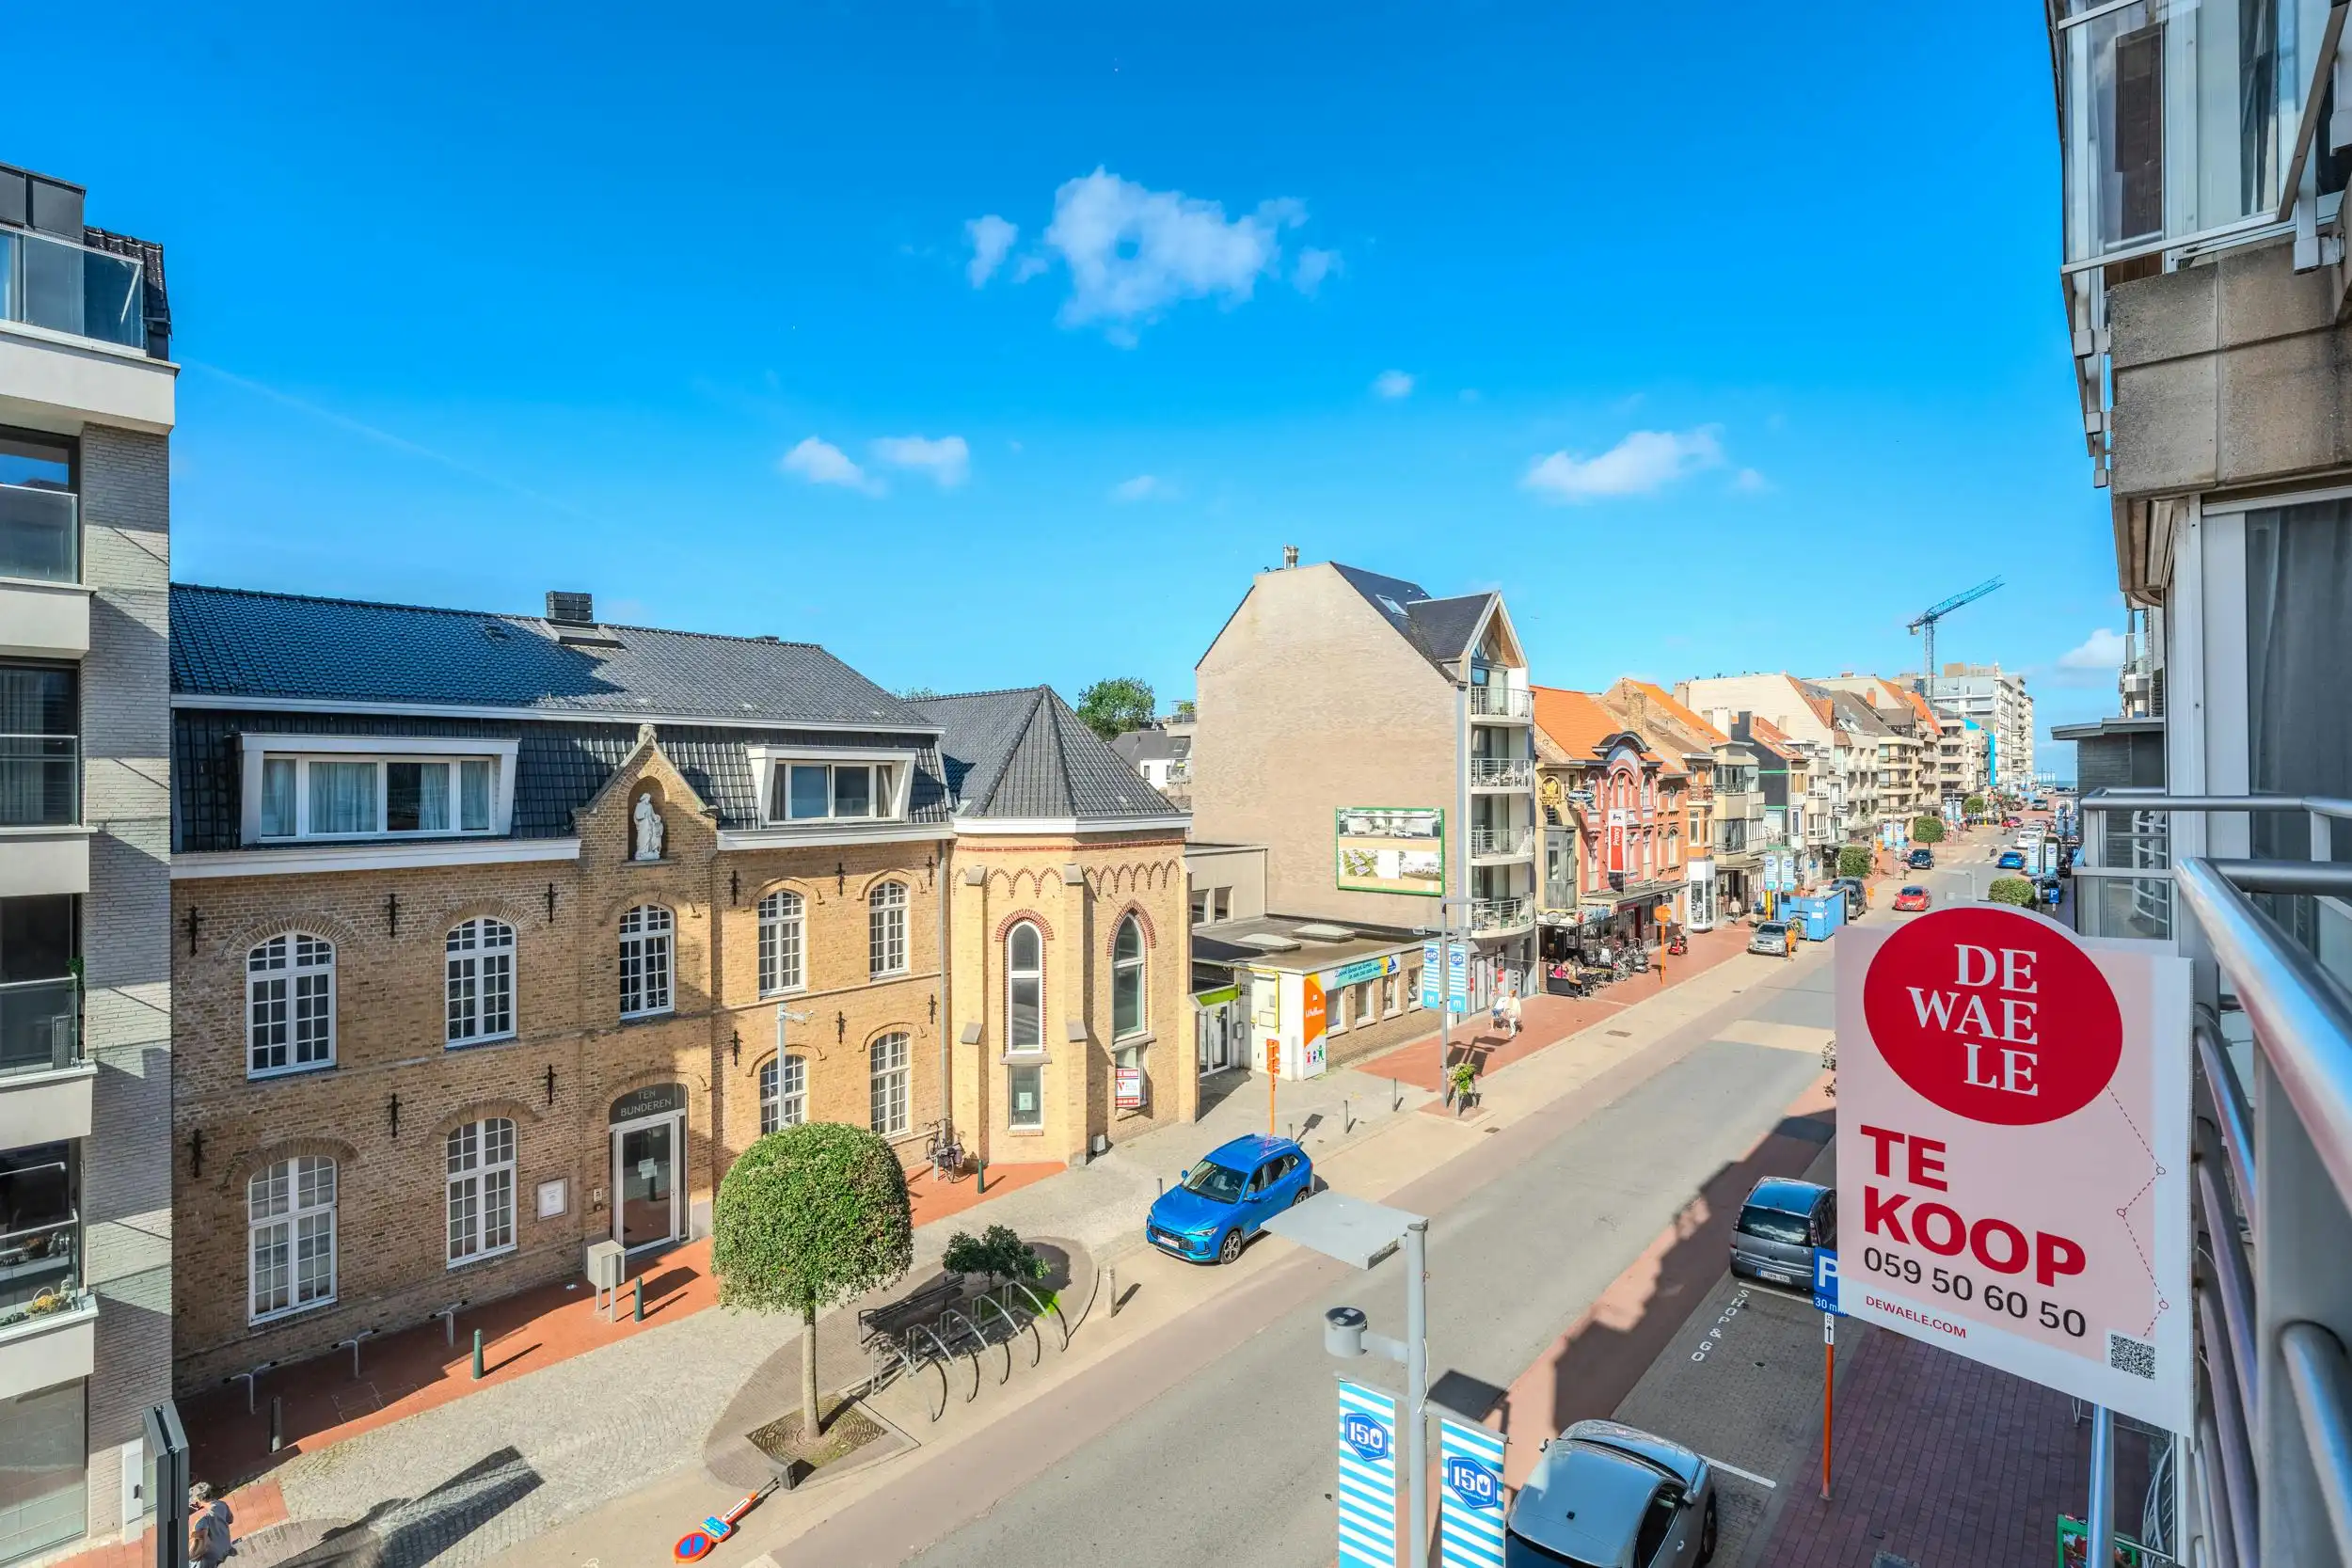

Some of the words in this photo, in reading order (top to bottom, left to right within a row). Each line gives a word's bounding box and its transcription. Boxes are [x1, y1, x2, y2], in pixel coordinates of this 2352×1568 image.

[1613, 827, 1622, 846] Proxy
[2050, 889, 2058, 898] P
[1954, 943, 2039, 994] DE
[1906, 987, 2039, 1045] WAE
[1963, 1043, 2039, 1097] LE
[620, 1099, 672, 1117] BUNDEREN
[638, 1088, 656, 1100] TEN
[1860, 1124, 1948, 1192] TE
[1864, 1186, 2087, 1288] KOOP
[1819, 1255, 1838, 1288] P
[1717, 1290, 1750, 1324] SHOP
[1815, 1297, 1828, 1308] 30
[1864, 1247, 1922, 1286] 059
[1931, 1268, 1973, 1301] 50
[1984, 1285, 2027, 1319] 60
[2040, 1302, 2087, 1338] 50
[1866, 1295, 1967, 1338] DEWAELE.COM
[1709, 1328, 1722, 1338] &
[1691, 1341, 1713, 1362] GO
[1348, 1421, 1383, 1449] 150
[1454, 1465, 1491, 1497] 150
